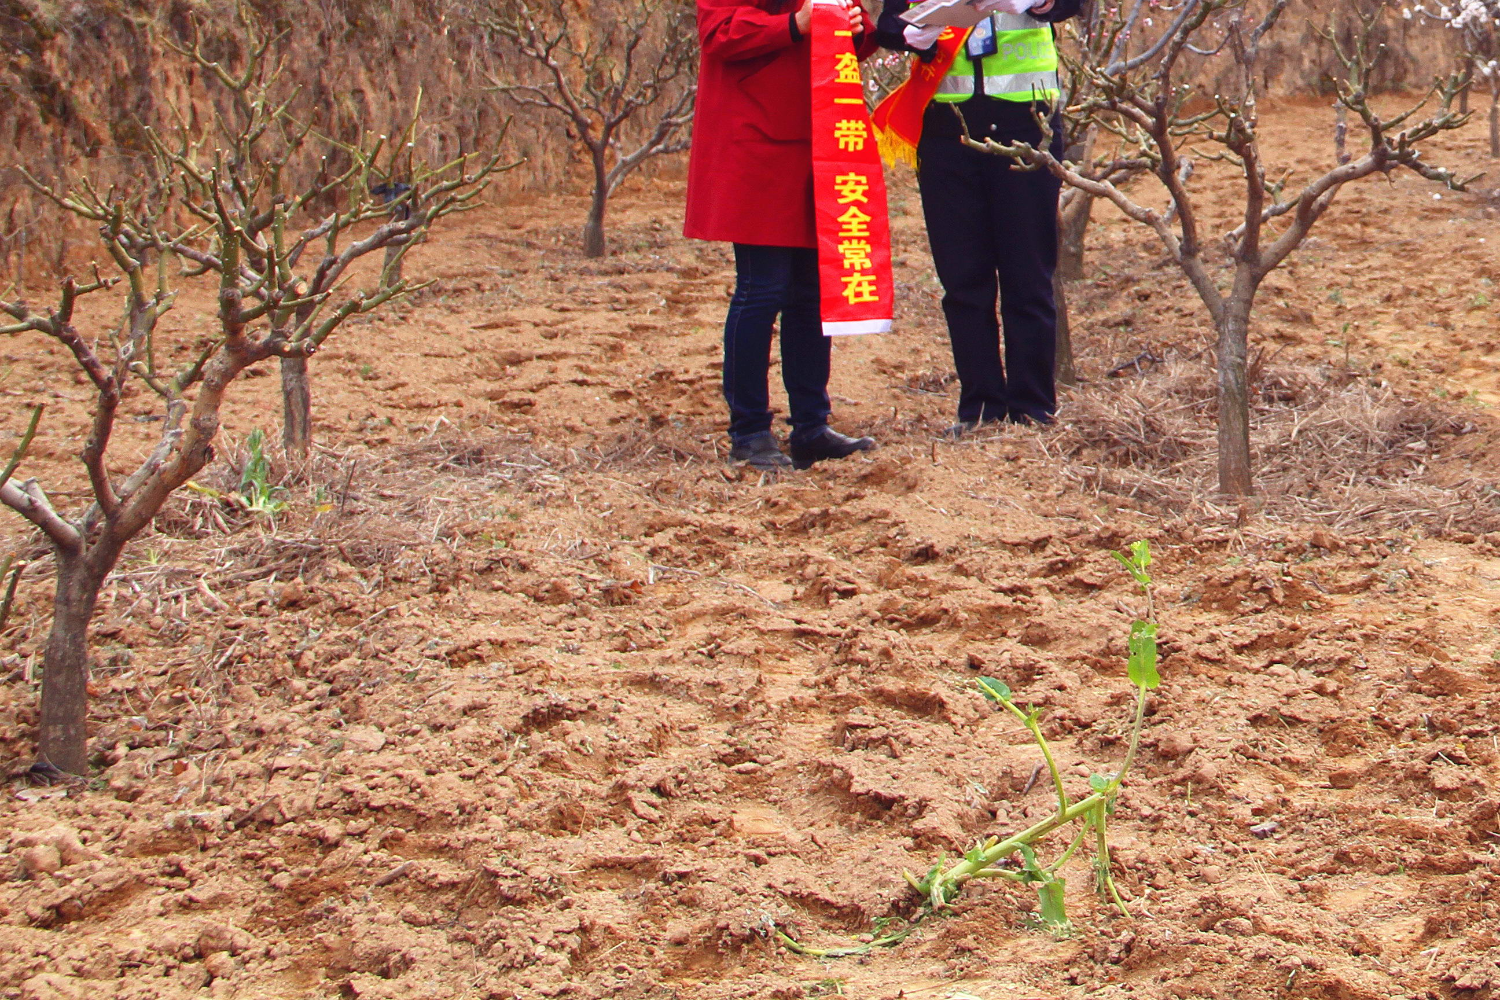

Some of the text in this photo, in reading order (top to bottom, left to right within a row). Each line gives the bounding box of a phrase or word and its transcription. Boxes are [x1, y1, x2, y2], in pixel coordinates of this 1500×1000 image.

[834, 29, 880, 306] 一盔一带 安全常在
